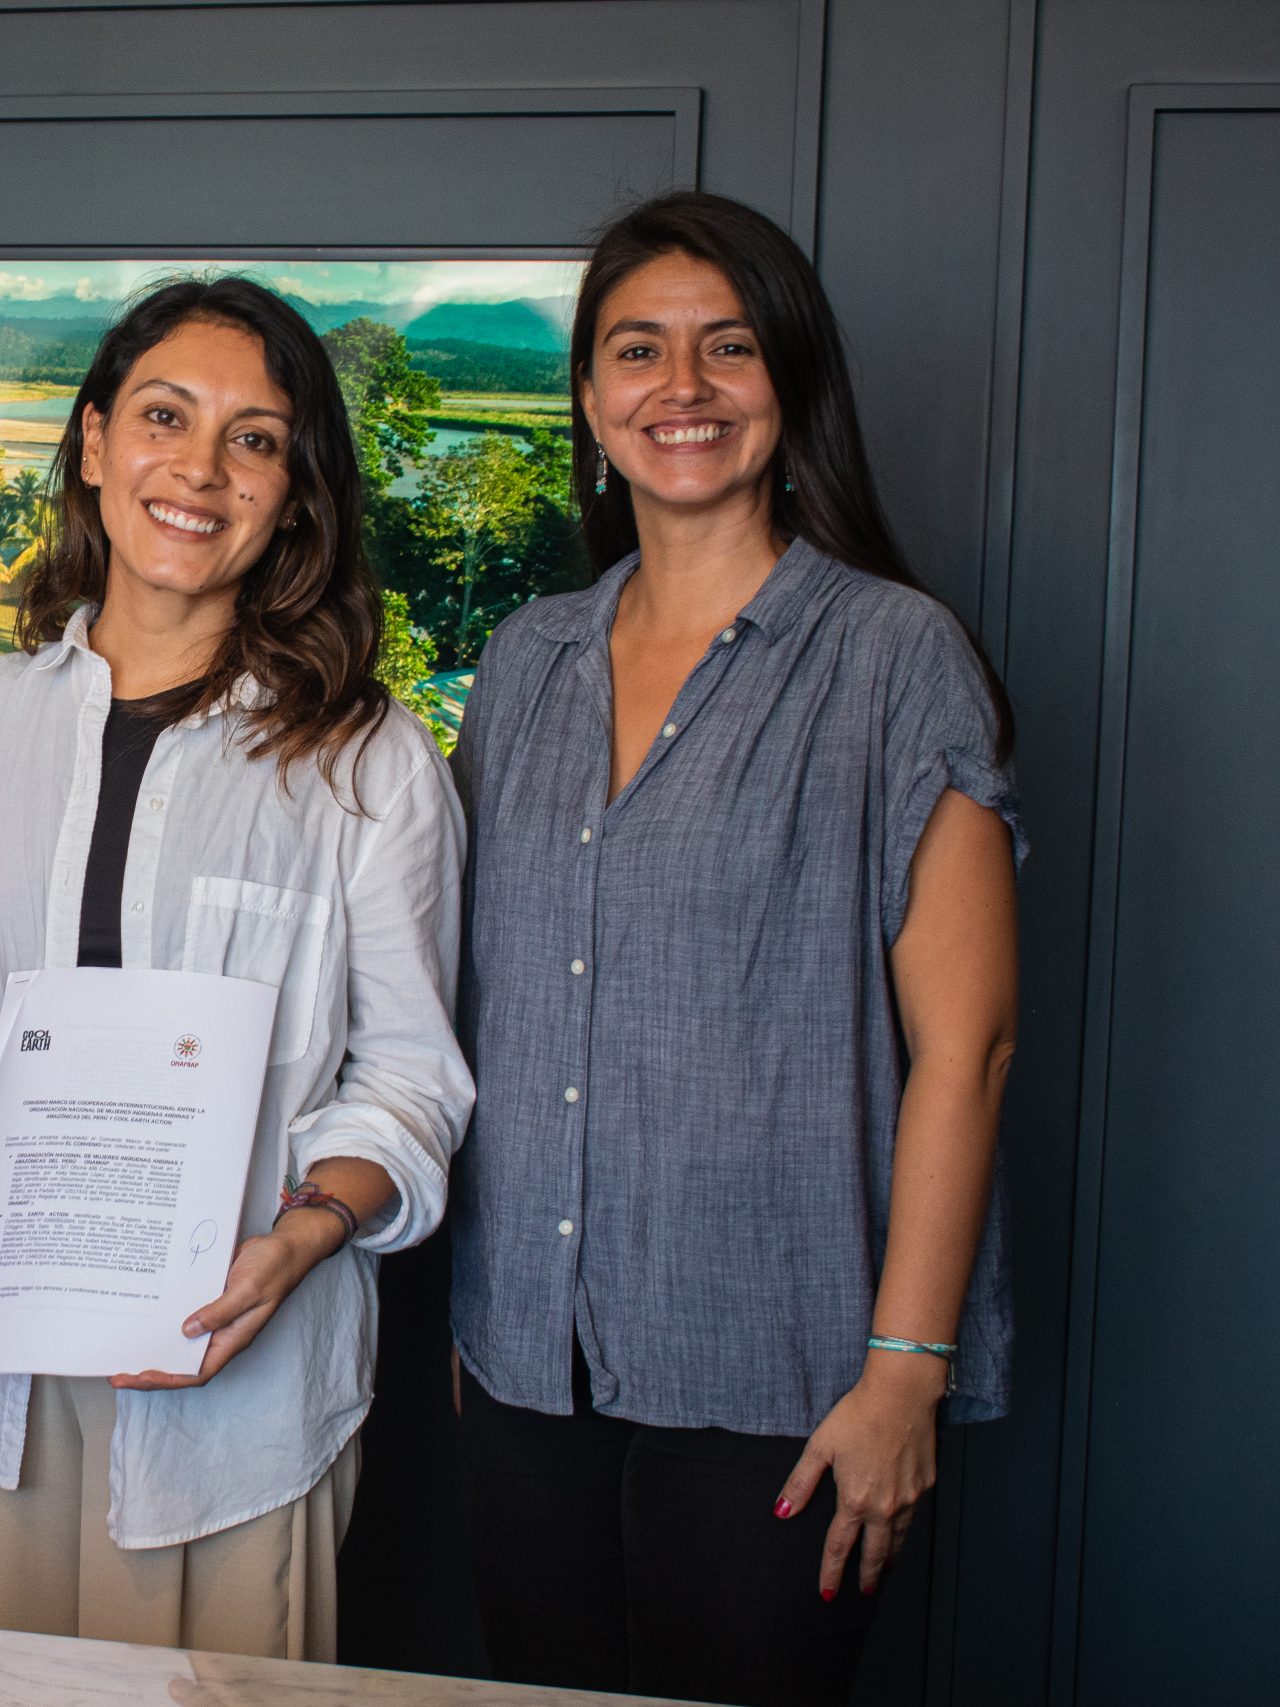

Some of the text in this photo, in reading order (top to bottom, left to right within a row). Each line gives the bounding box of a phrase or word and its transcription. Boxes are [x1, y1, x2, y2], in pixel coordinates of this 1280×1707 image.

[23, 1030, 51, 1039] COOL
[21, 1037, 51, 1051] EARTH
[118, 1102, 175, 1111] INTERINSTITUCIONAL
[164, 1112, 189, 1120] ANDINAS
[151, 1118, 173, 1126] ACTION
